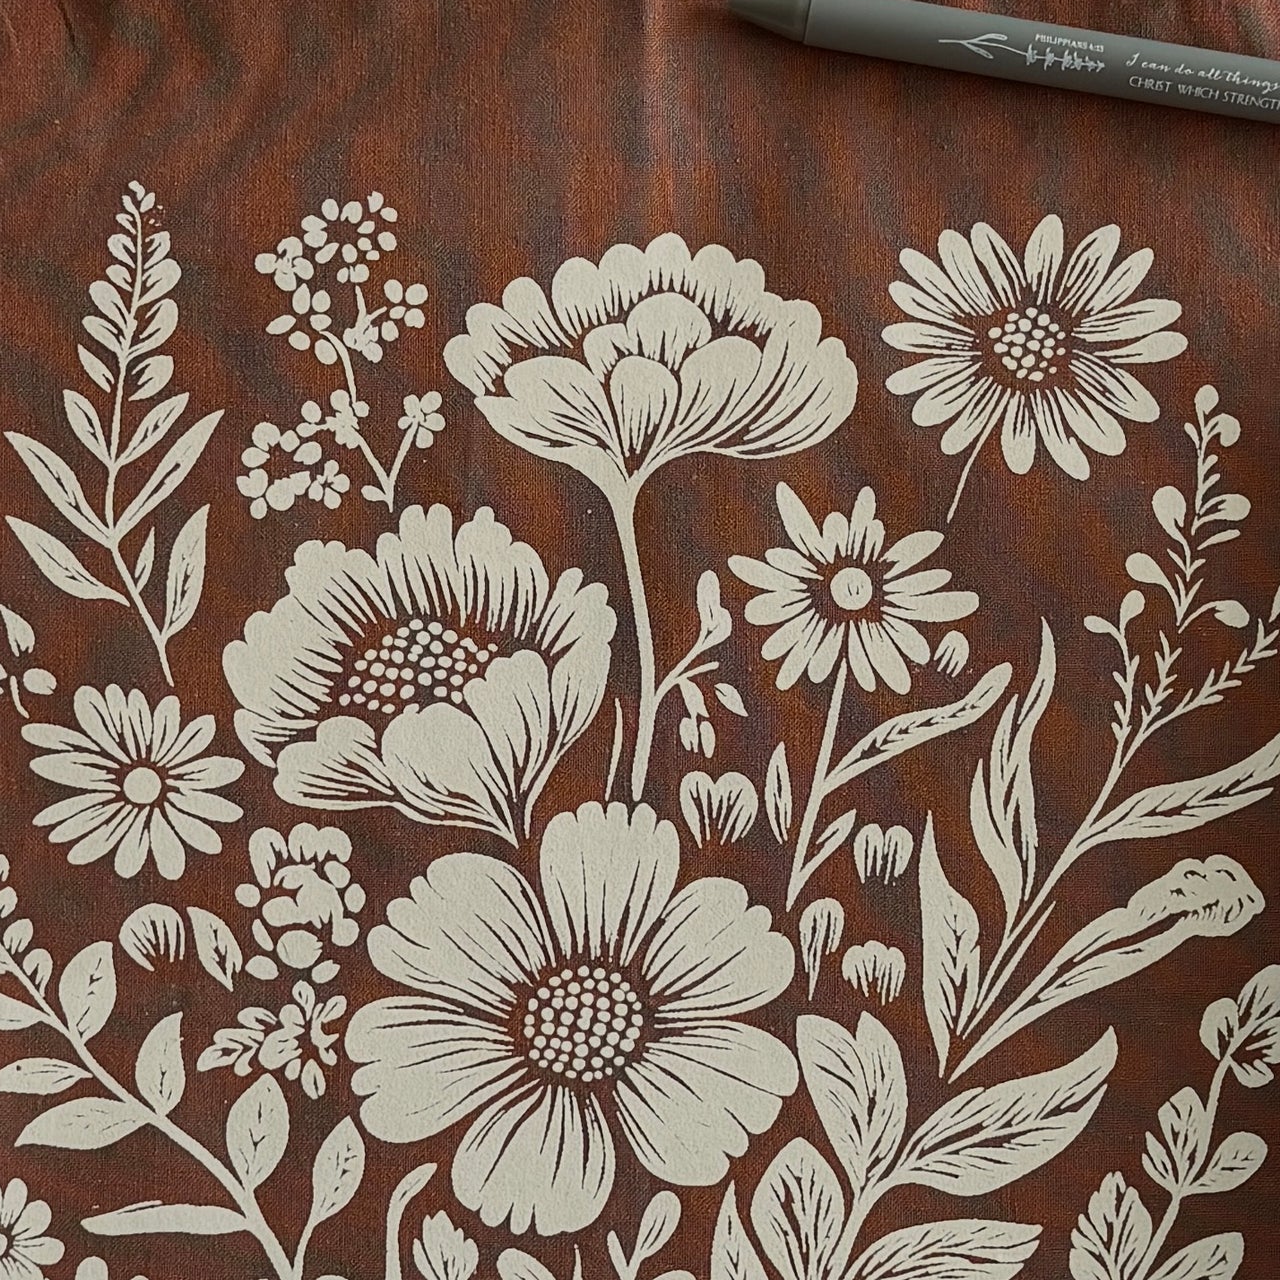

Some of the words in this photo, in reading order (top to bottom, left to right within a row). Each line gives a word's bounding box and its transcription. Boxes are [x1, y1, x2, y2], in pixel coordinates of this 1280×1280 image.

[1126, 52, 1140, 67] I
[1141, 61, 1171, 72] can
[1174, 63, 1195, 76] do
[1197, 67, 1223, 81] all
[1129, 75, 1173, 93] CHRIST
[1177, 83, 1219, 100] WHICH
